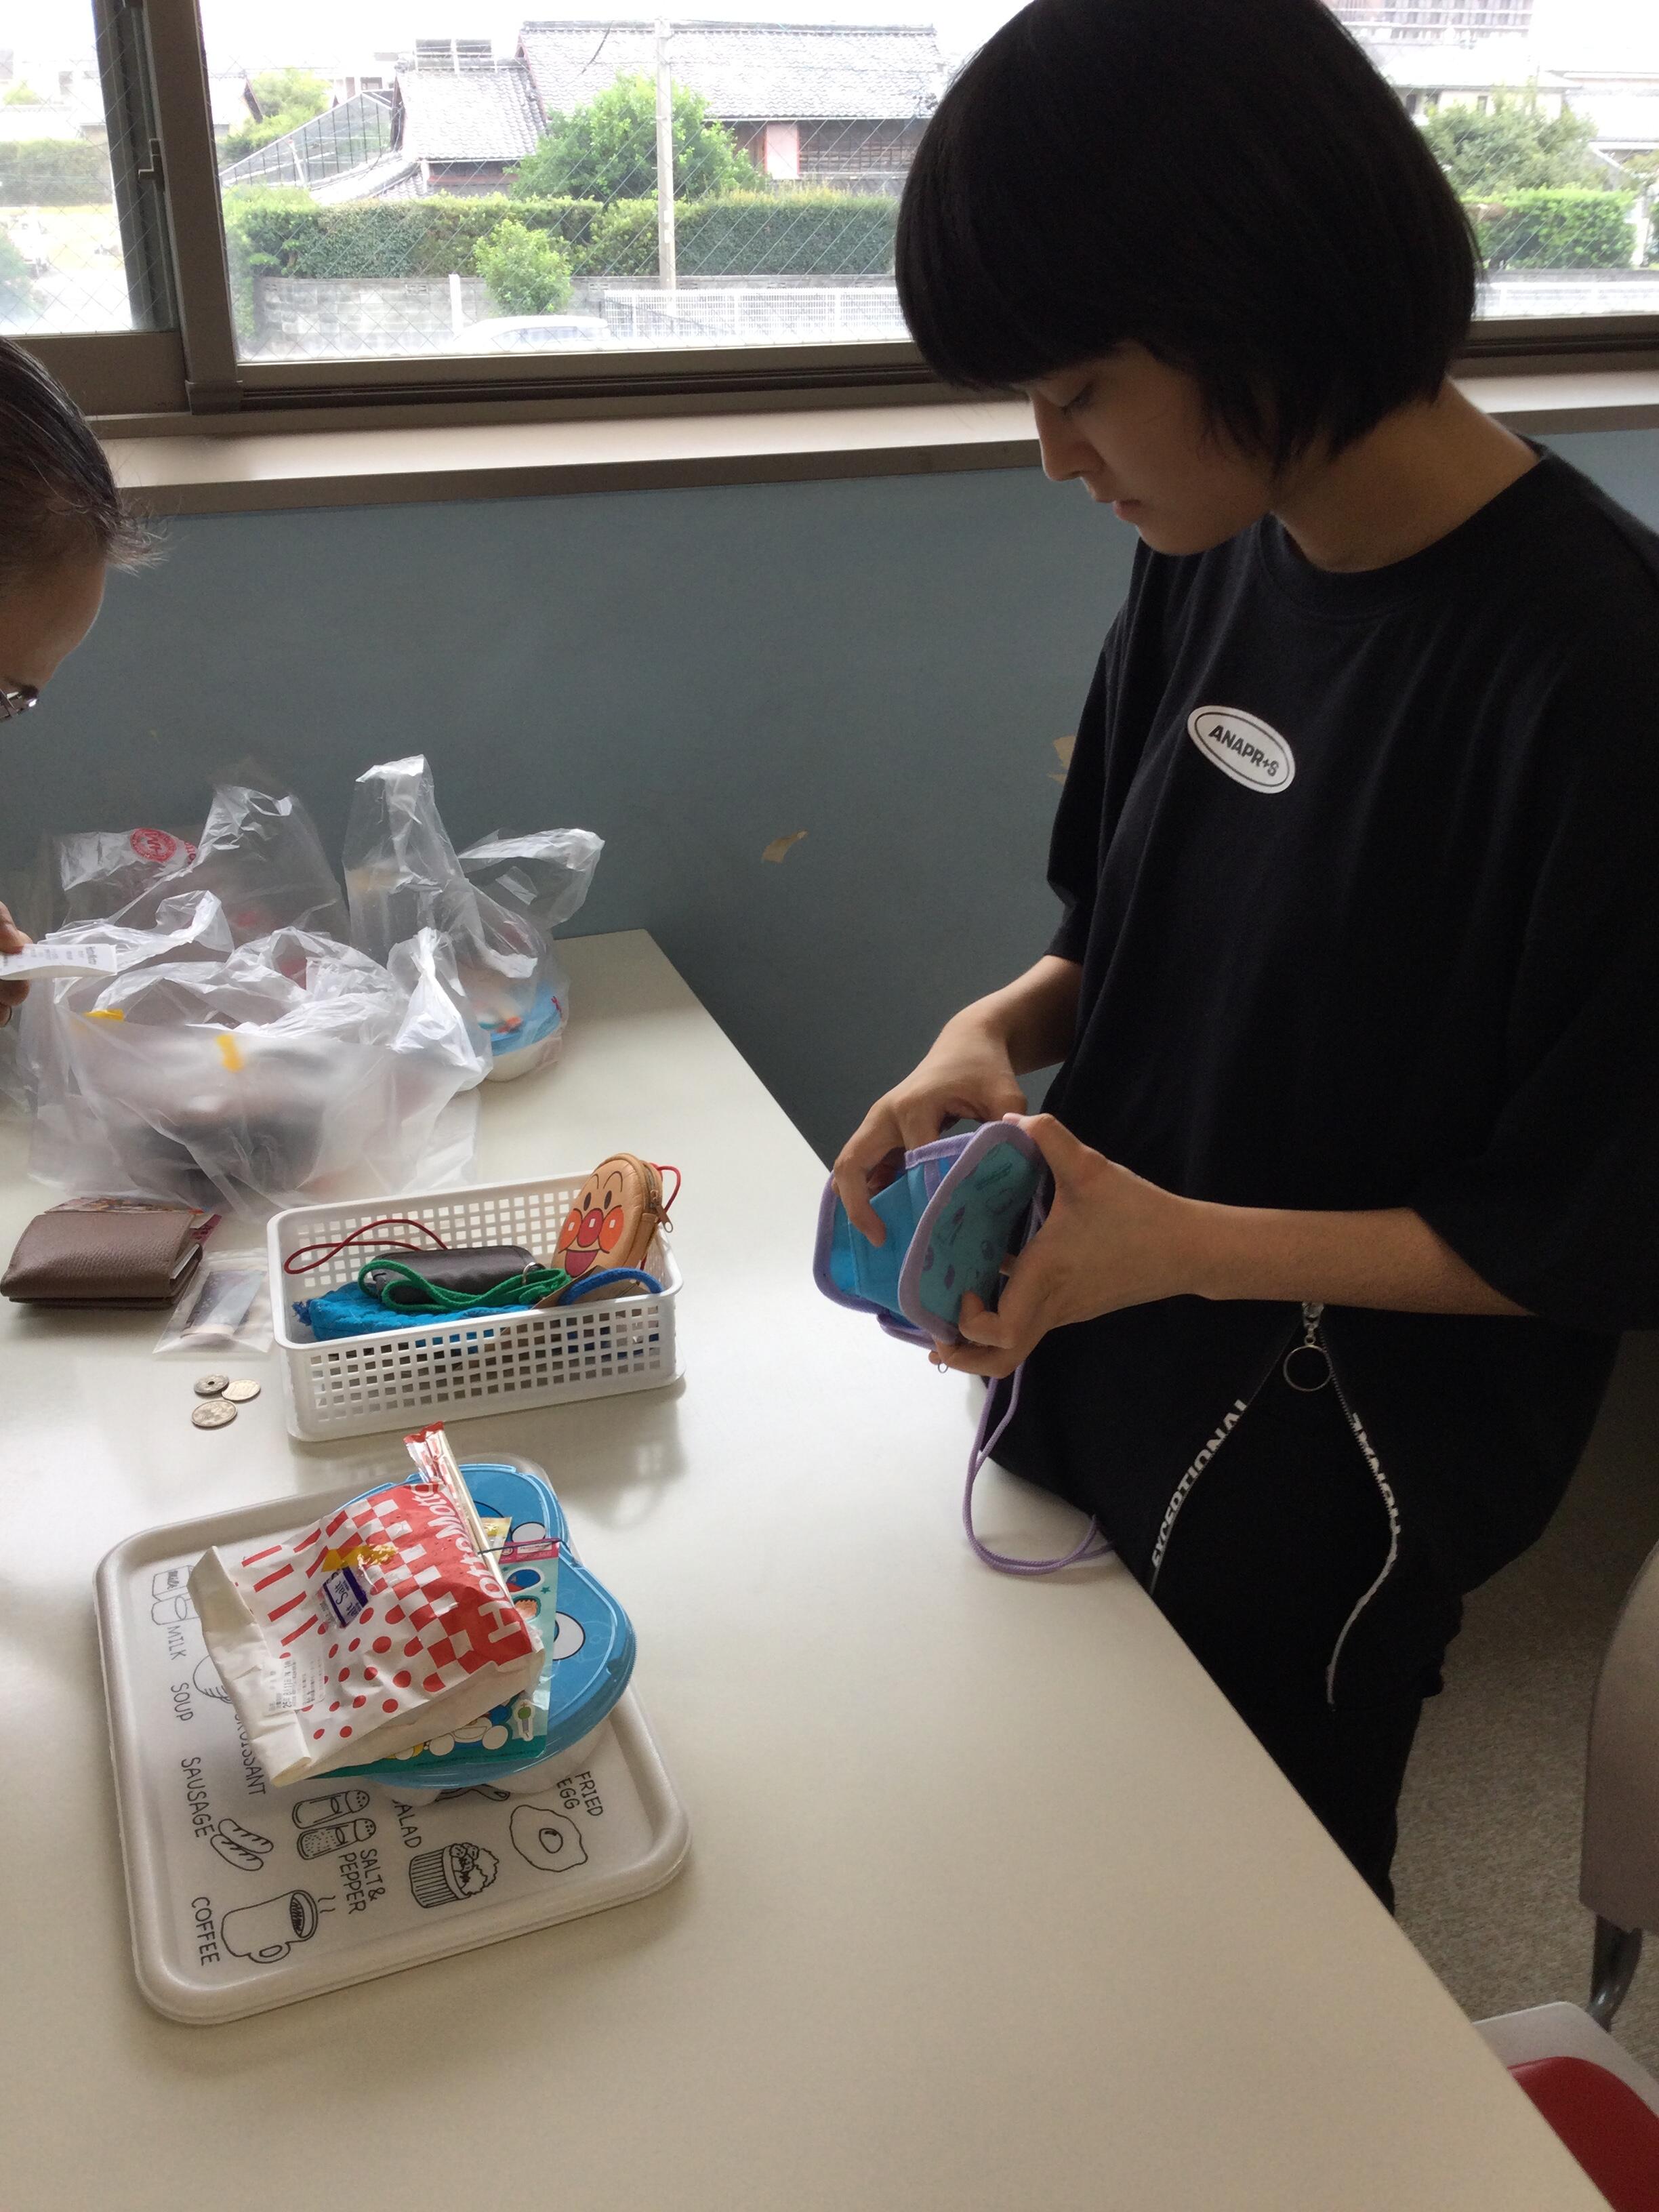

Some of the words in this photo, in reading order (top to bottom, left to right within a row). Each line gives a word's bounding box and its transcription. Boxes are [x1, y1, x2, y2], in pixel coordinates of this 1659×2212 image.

[334, 1580, 348, 1605] Salt
[167, 1625, 187, 1660] MILK
[171, 1682, 194, 1721] SOUP
[181, 1756, 216, 1837] SAUSAGE
[556, 1778, 580, 1809] EGG
[575, 1770, 603, 1816] FRIED
[392, 1799, 422, 1848] ALAD
[339, 1851, 367, 1914] PEPPER
[191, 1896, 220, 1966] COFFEE
